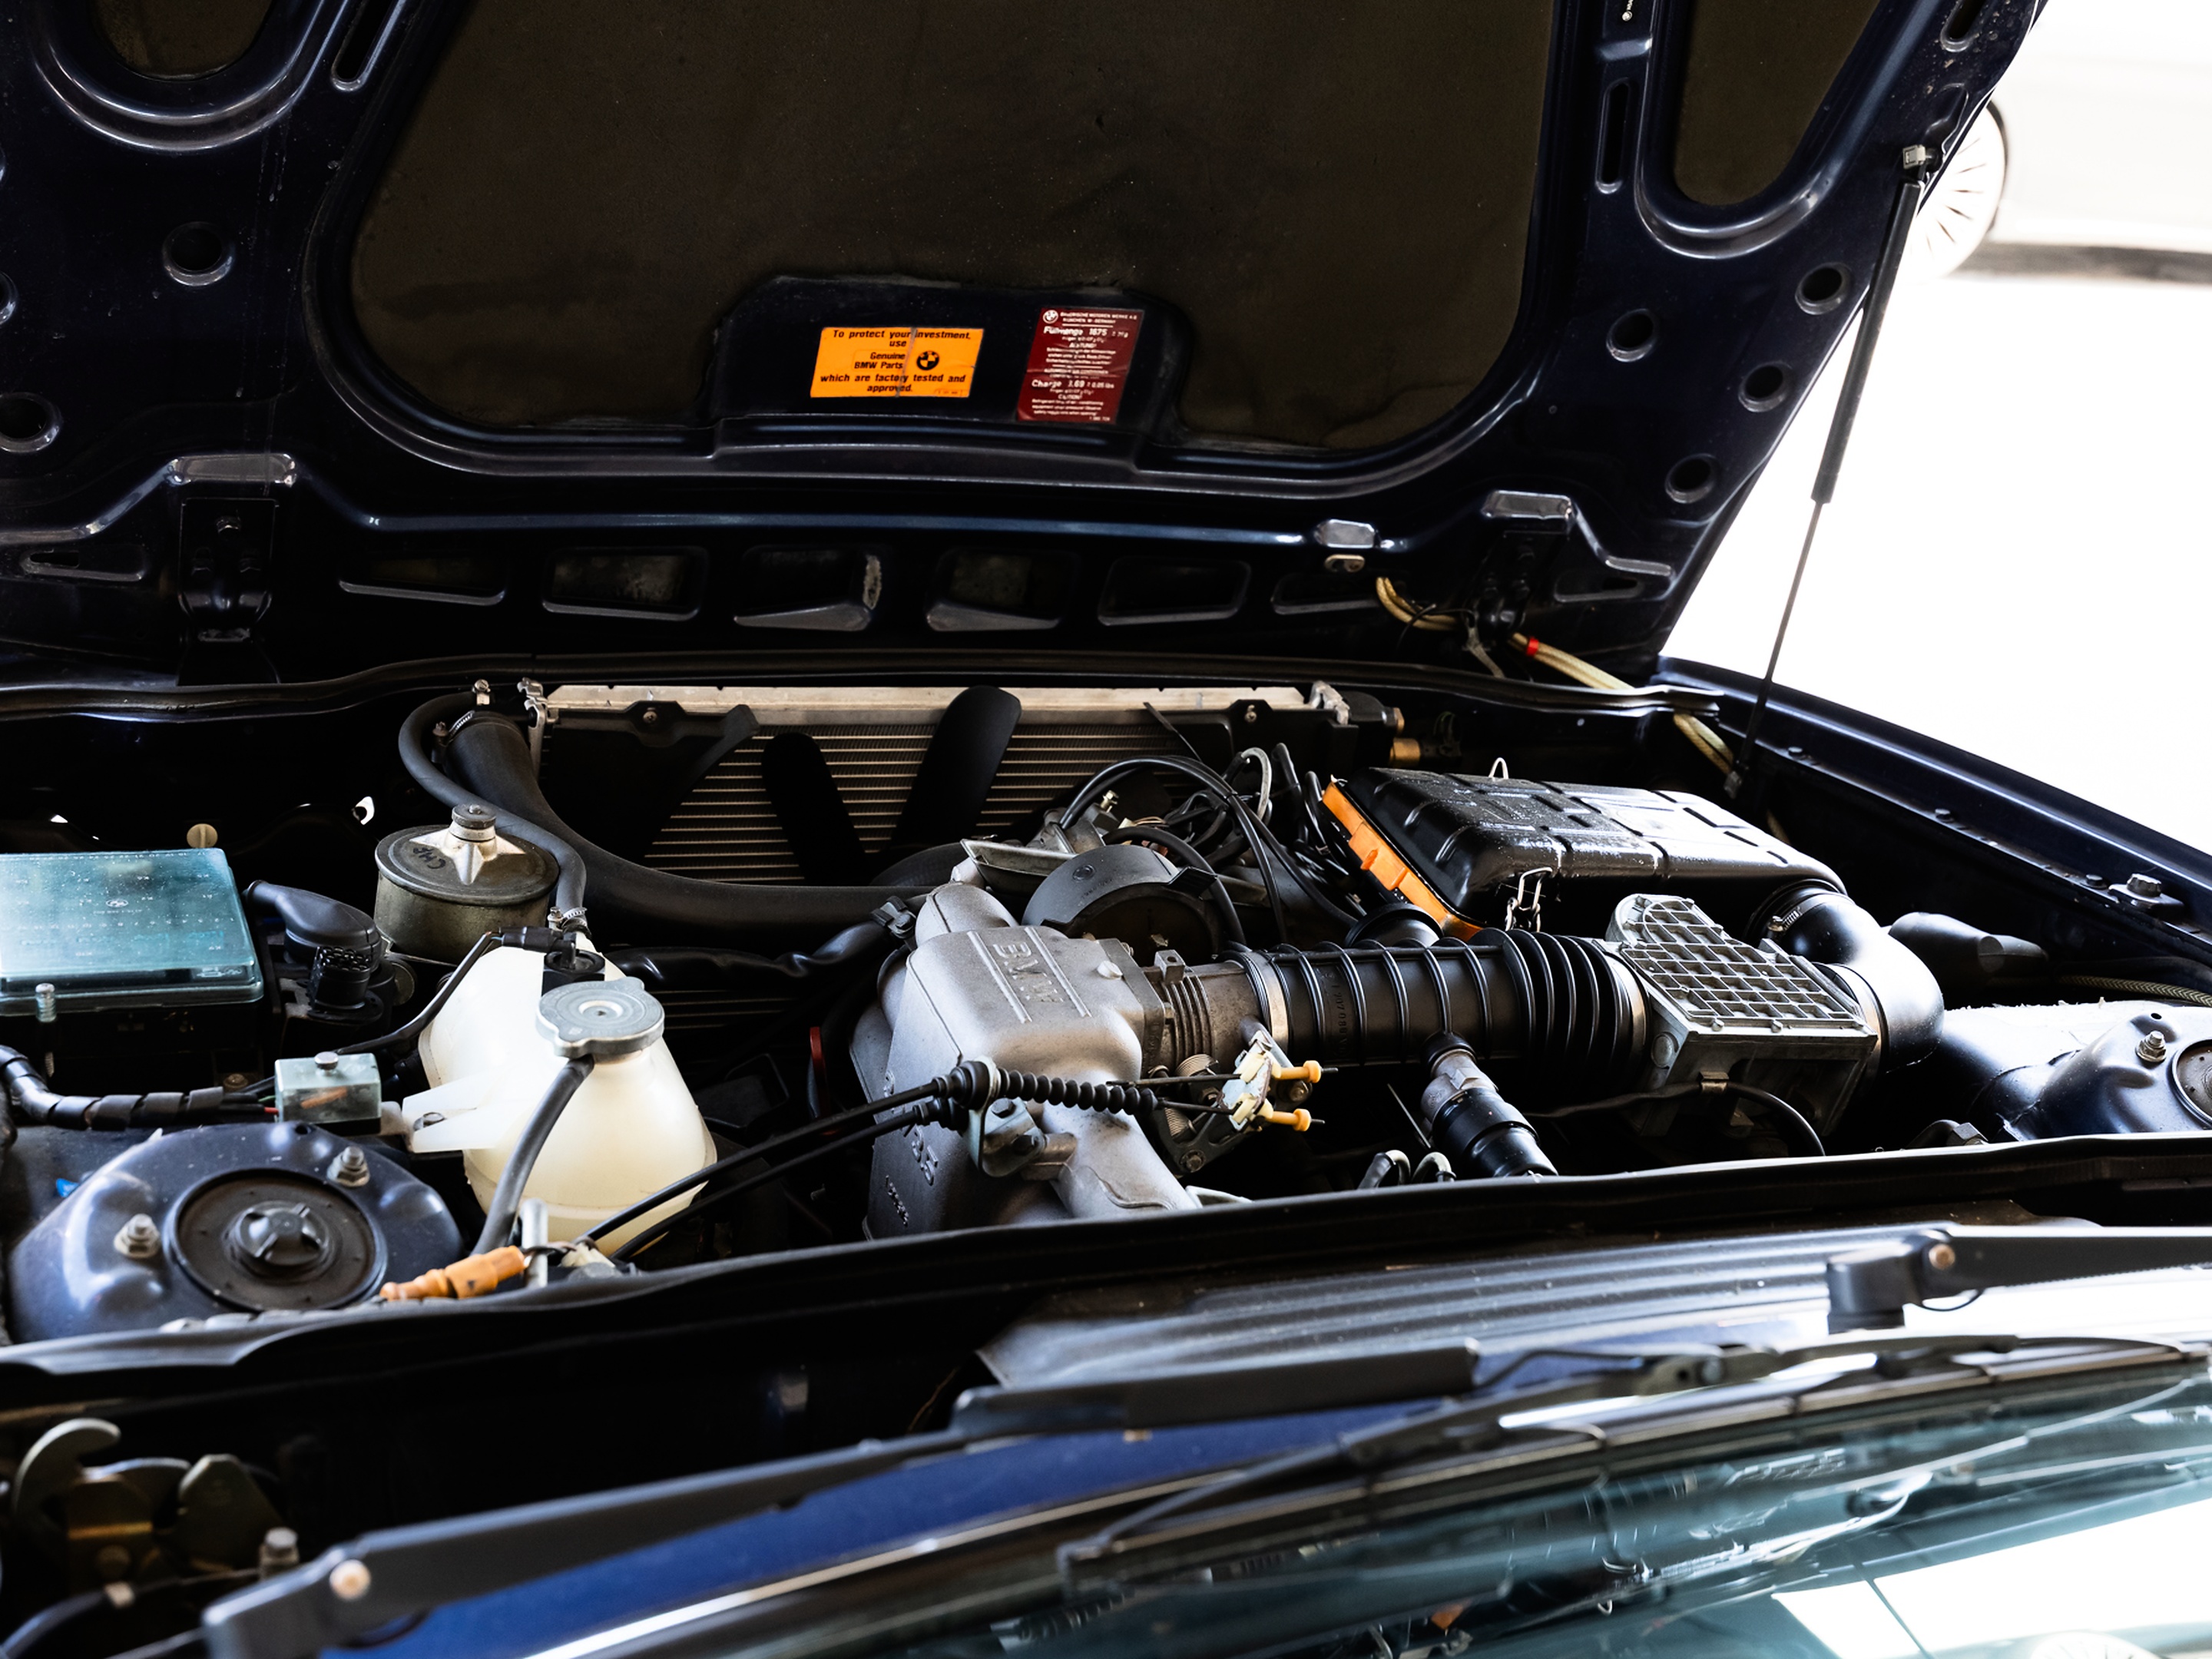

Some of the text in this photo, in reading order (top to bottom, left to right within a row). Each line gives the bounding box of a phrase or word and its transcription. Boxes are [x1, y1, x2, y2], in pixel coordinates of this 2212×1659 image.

[833, 329, 845, 338] To
[849, 329, 885, 339] protect
[870, 352, 906, 360] Genuine
[880, 361, 903, 369] Parts
[820, 373, 850, 382] which
[913, 374, 944, 382] tested
[1031, 379, 1062, 389] Charge
